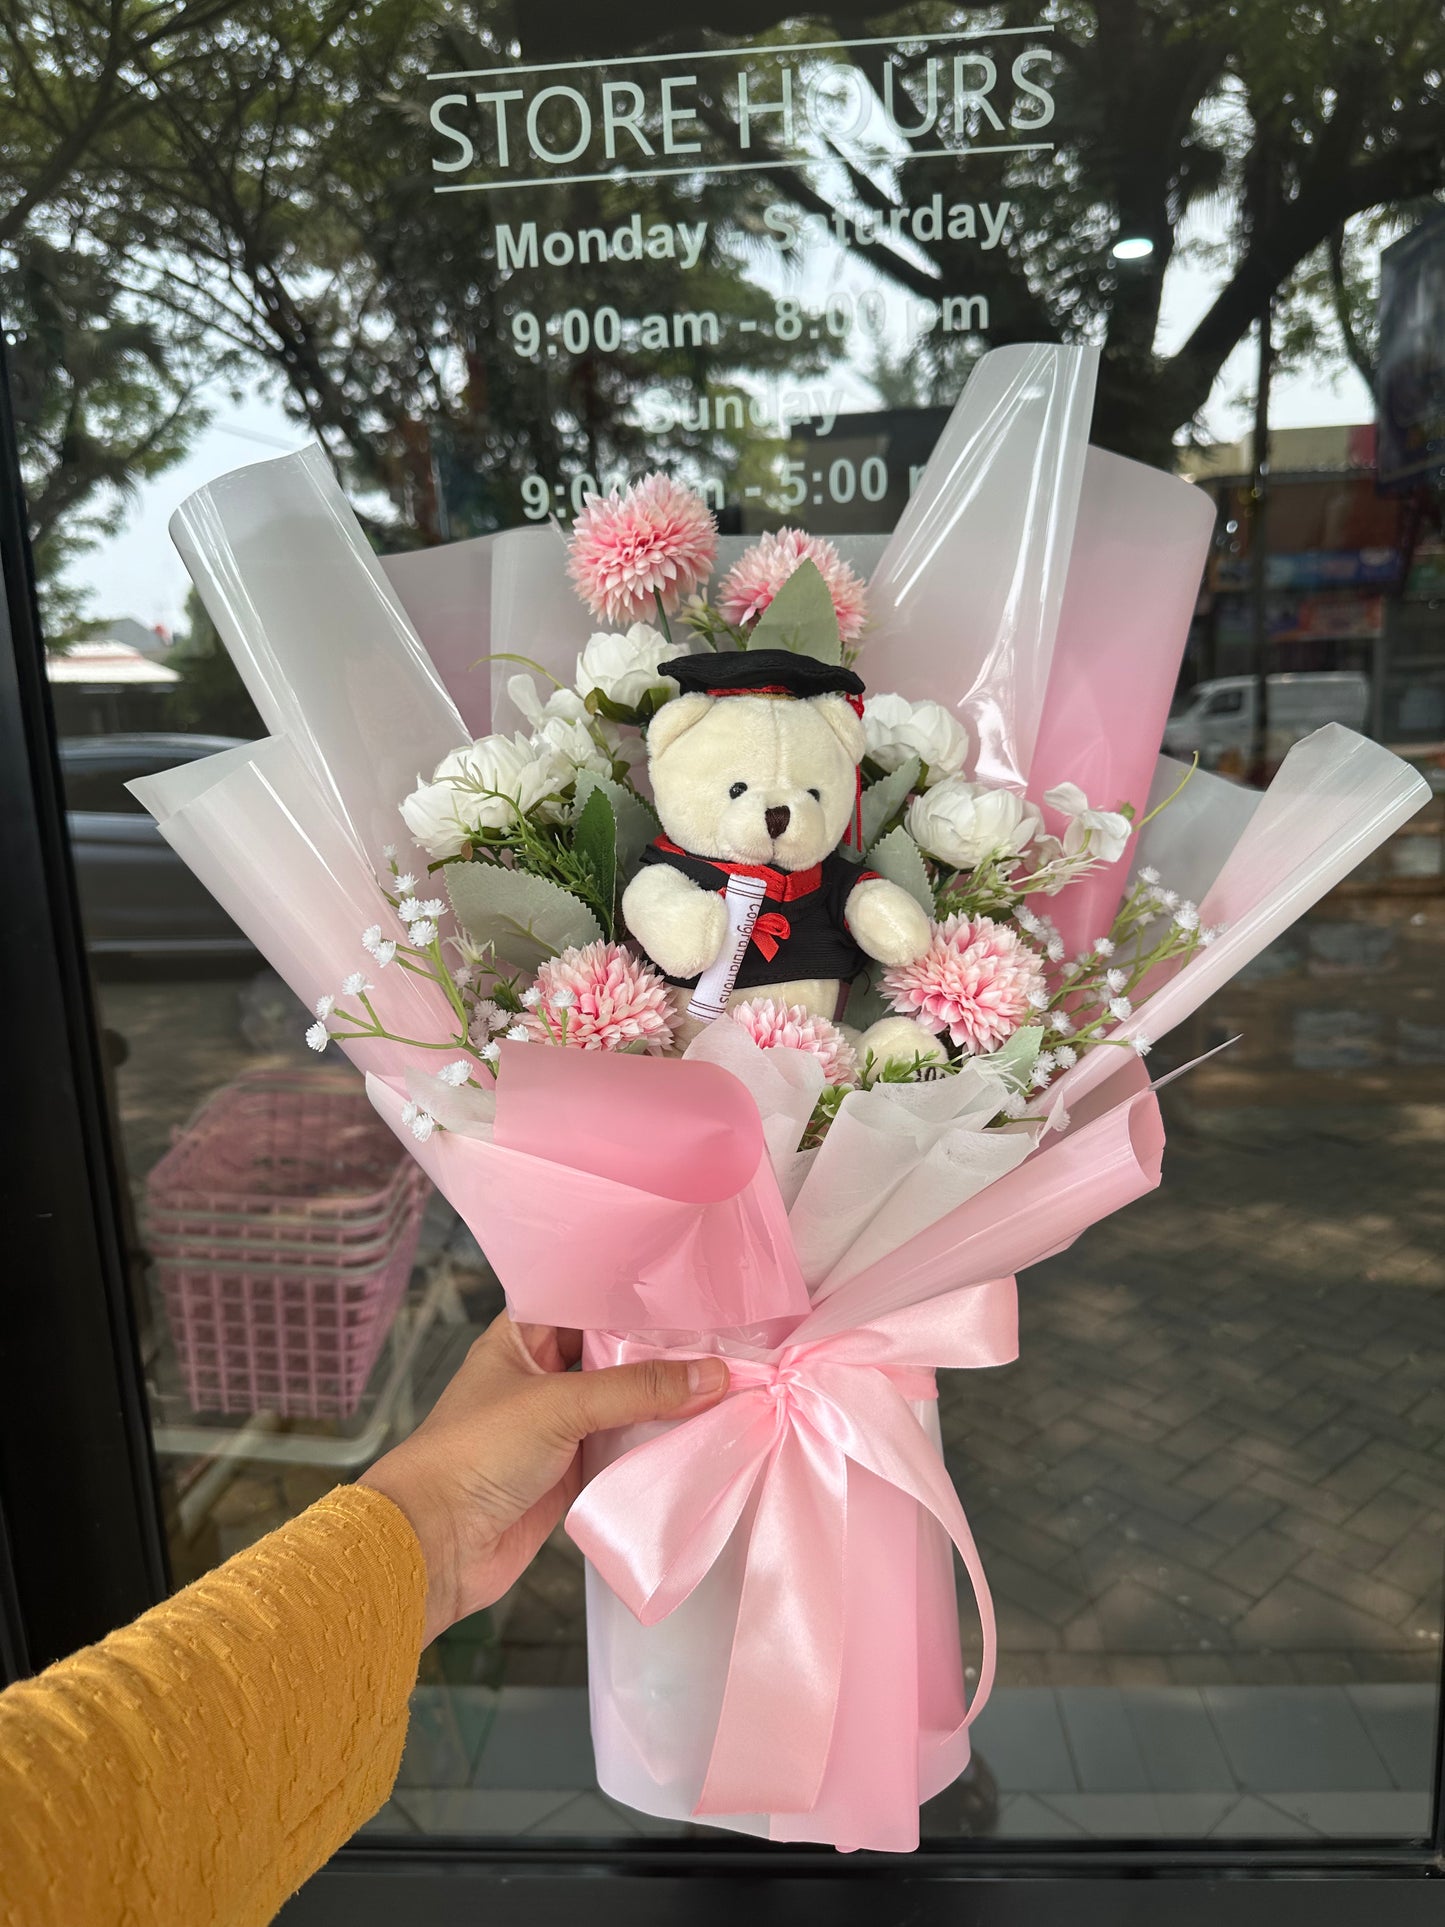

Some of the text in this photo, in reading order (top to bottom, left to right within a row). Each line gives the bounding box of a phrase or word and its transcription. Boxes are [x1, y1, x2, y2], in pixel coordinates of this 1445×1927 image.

[428, 49, 1055, 173] STORE HOURS
[494, 214, 707, 271] Monday
[763, 193, 1010, 250] Saturday
[511, 306, 621, 357] 9:00
[641, 310, 719, 349] am
[774, 290, 886, 342] 8:00
[905, 294, 989, 347] pm
[641, 382, 845, 436] Sunday
[781, 457, 888, 507] 5:00
